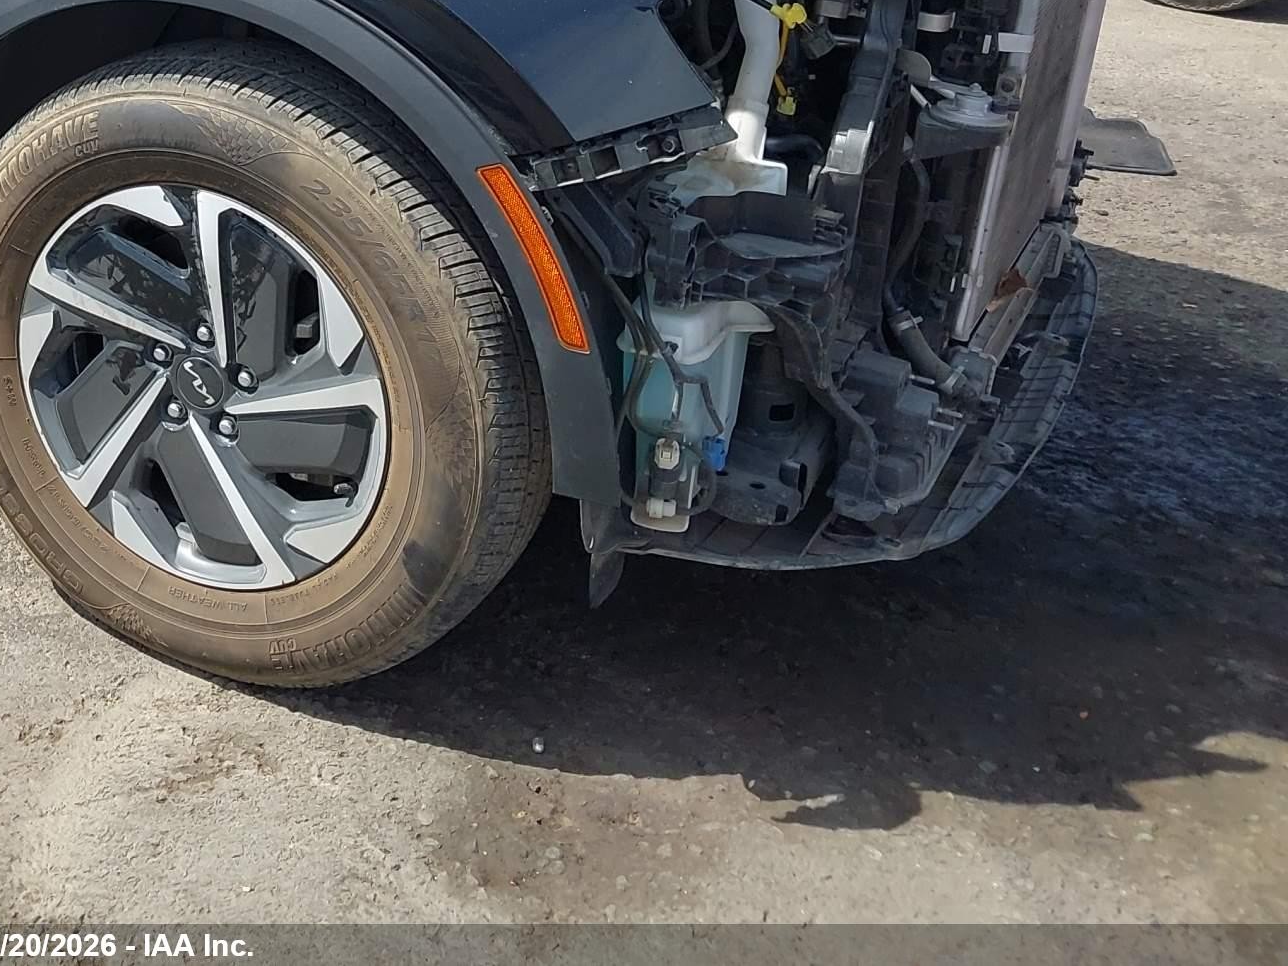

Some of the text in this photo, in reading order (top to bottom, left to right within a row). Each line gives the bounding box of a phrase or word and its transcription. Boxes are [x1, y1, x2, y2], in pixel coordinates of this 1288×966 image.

[75, 139, 100, 157] CUV
[167, 585, 226, 610] WEATHER
[269, 638, 298, 655] CUV
